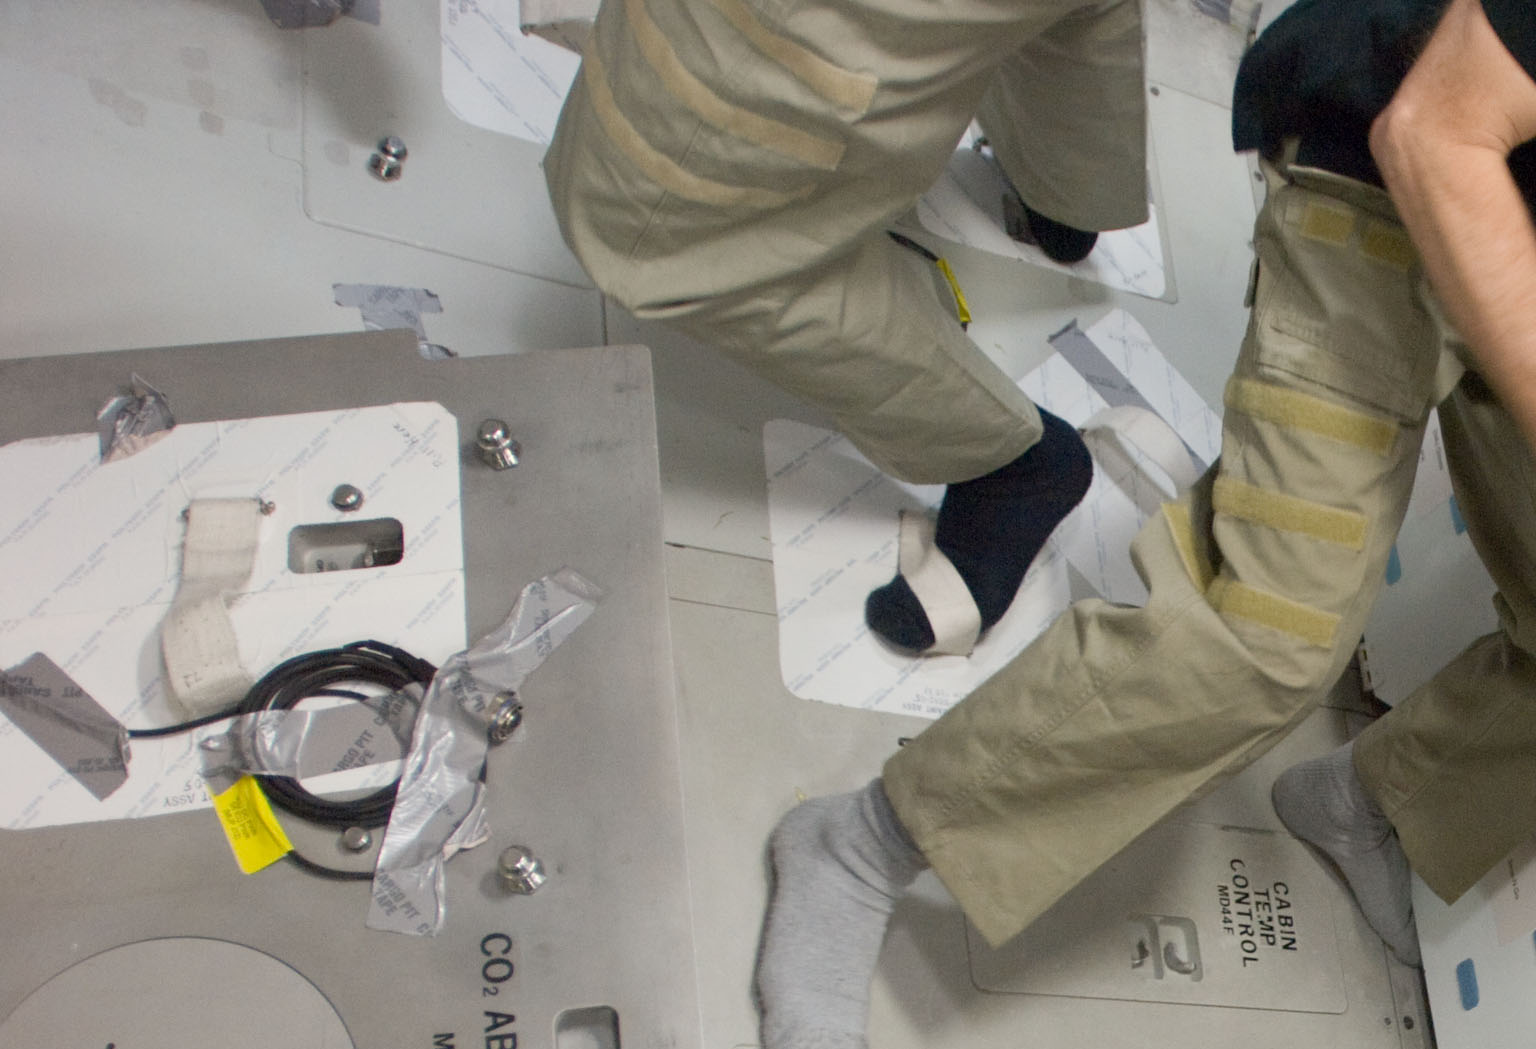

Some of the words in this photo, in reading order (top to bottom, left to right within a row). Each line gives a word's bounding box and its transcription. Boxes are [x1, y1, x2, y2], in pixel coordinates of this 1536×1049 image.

[333, 746, 360, 771] ARGO
[353, 729, 374, 749] PIT
[357, 748, 375, 766] APE
[162, 792, 195, 807] ASSY
[1216, 884, 1234, 934] MD44F
[1228, 857, 1258, 966] CONTROL
[1253, 887, 1276, 946] TEMP
[1272, 880, 1297, 951] CABIN
